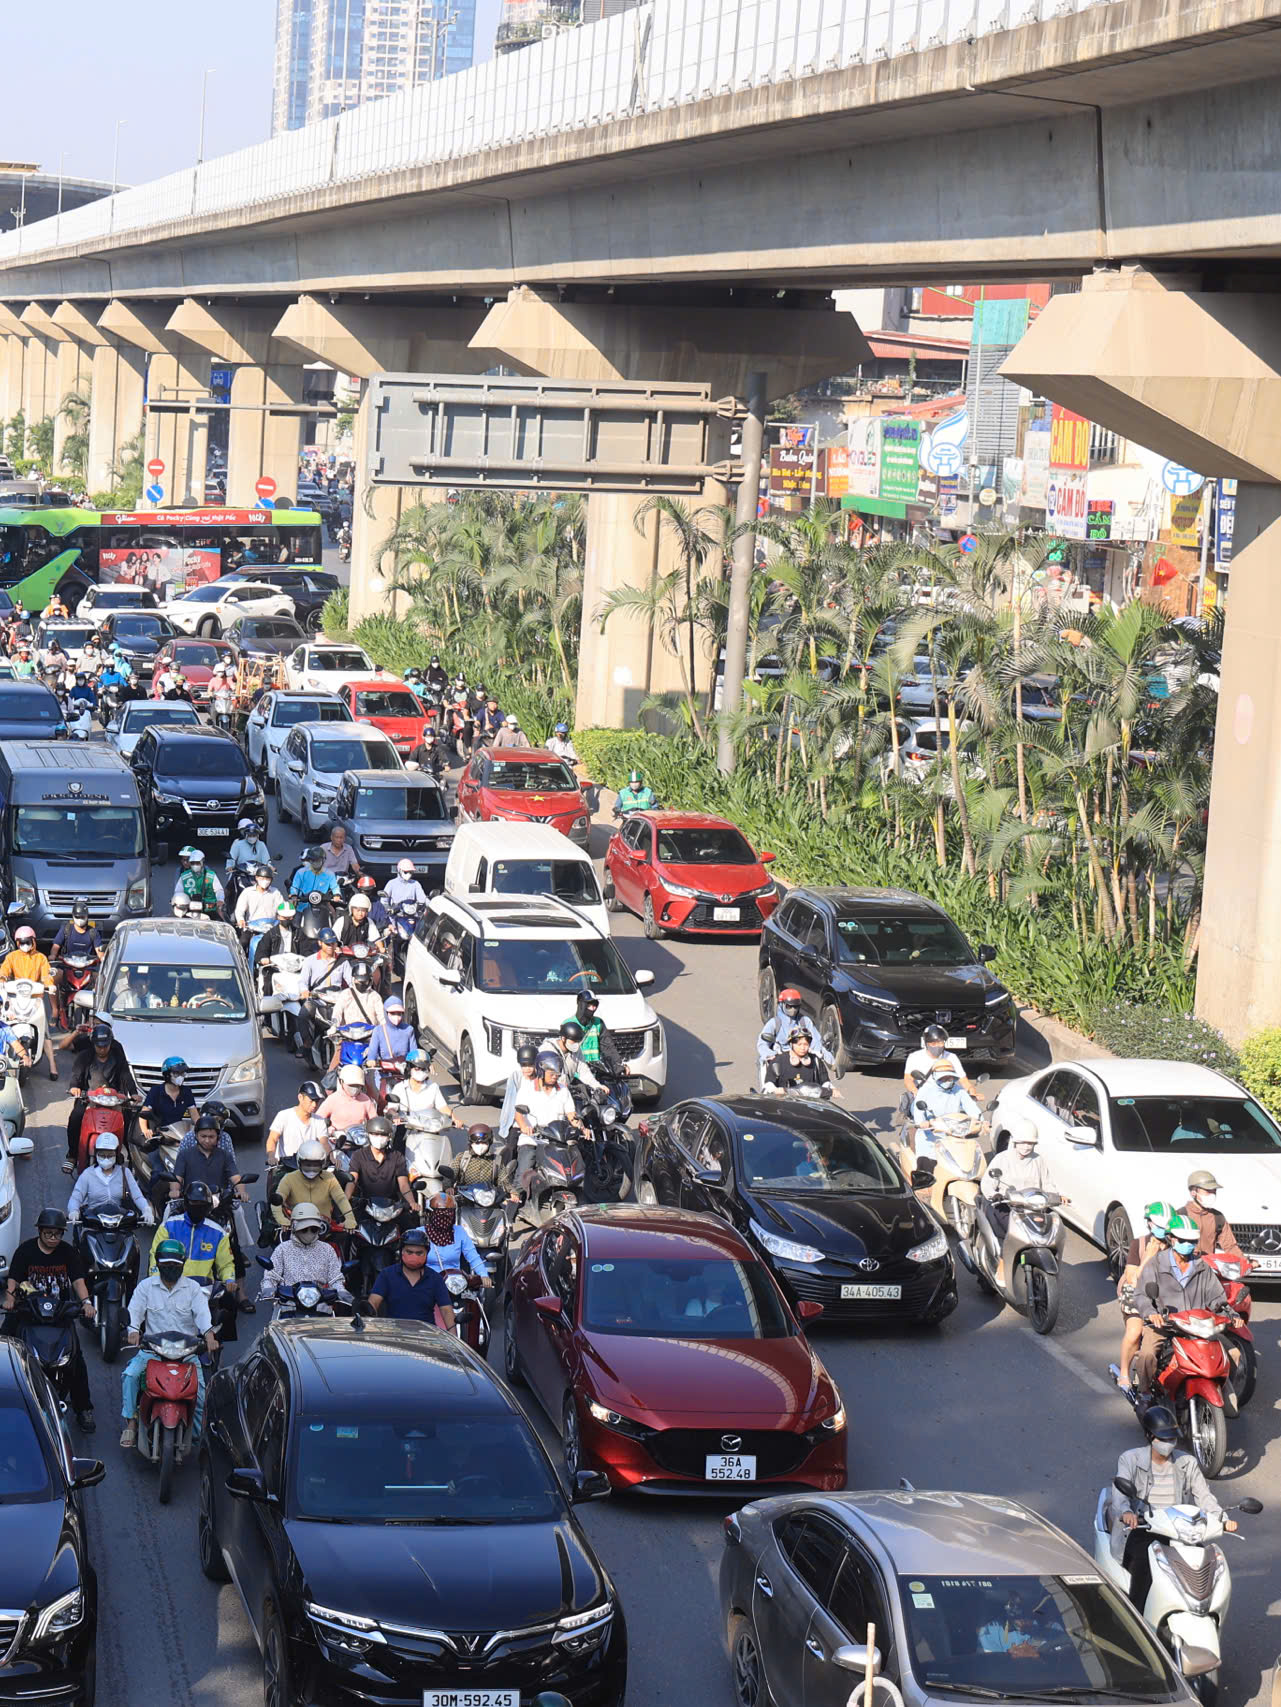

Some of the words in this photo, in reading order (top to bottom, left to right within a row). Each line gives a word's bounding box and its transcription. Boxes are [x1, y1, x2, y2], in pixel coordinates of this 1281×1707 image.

[201, 1241, 214, 1252] be
[842, 1286, 900, 1299] 34A-405.43
[720, 1457, 742, 1468] 36A
[711, 1468, 751, 1480] 552.48
[432, 1694, 513, 1707] 30M-592.45
